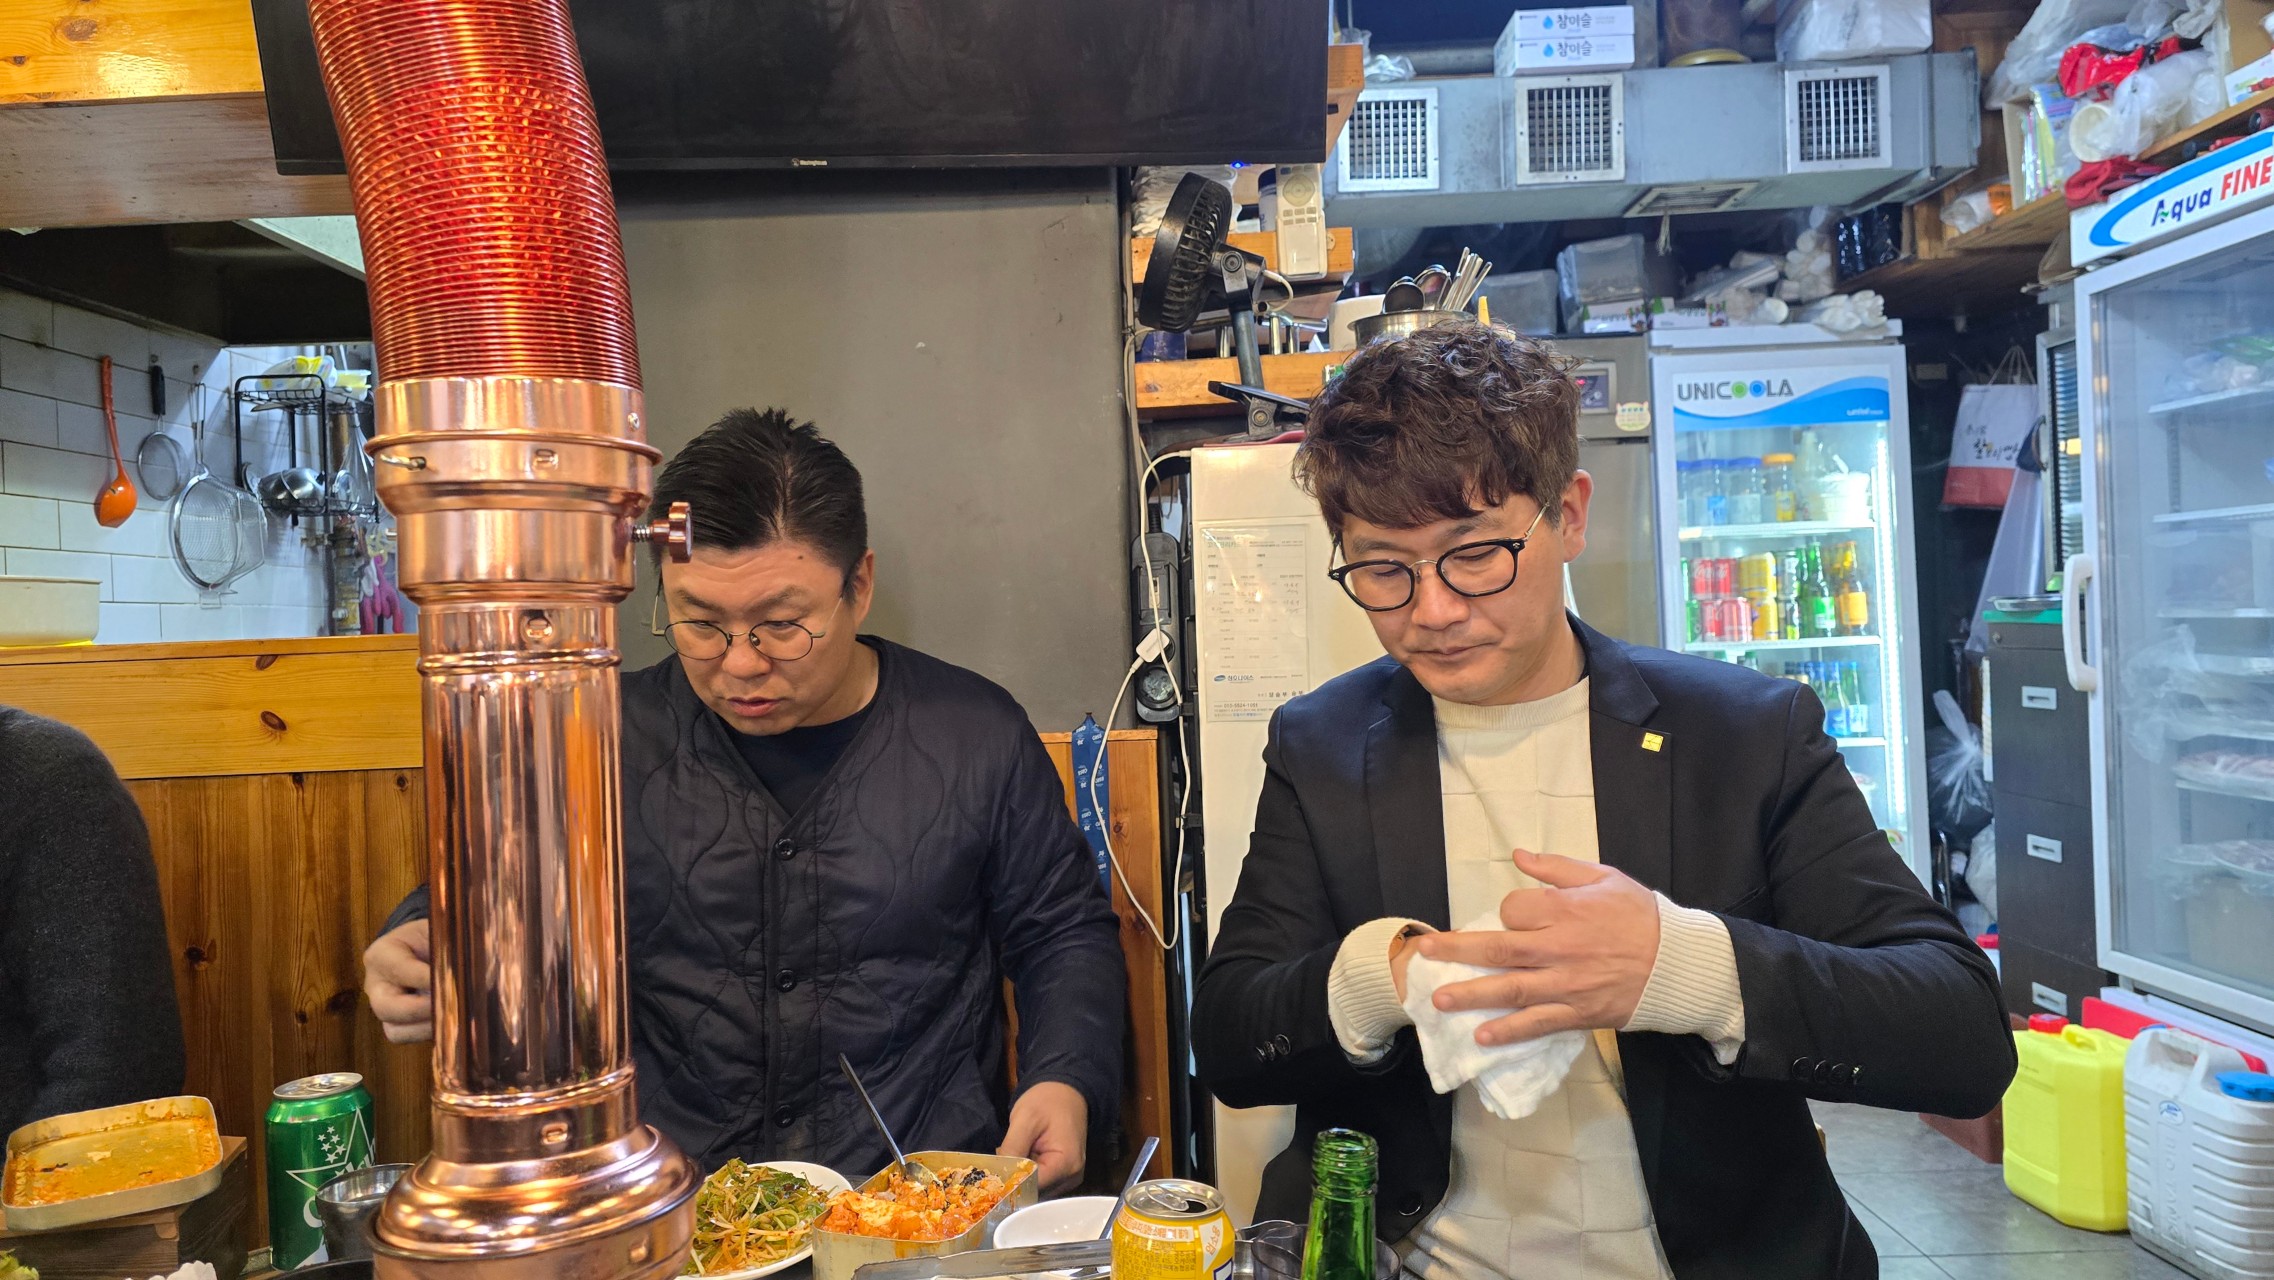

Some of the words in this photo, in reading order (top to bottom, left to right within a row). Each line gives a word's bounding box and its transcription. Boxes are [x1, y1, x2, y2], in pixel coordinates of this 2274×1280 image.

[1557, 13, 1592, 29] 참이슬
[1557, 41, 1592, 57] 참이슬
[2151, 187, 2213, 227] Aqua
